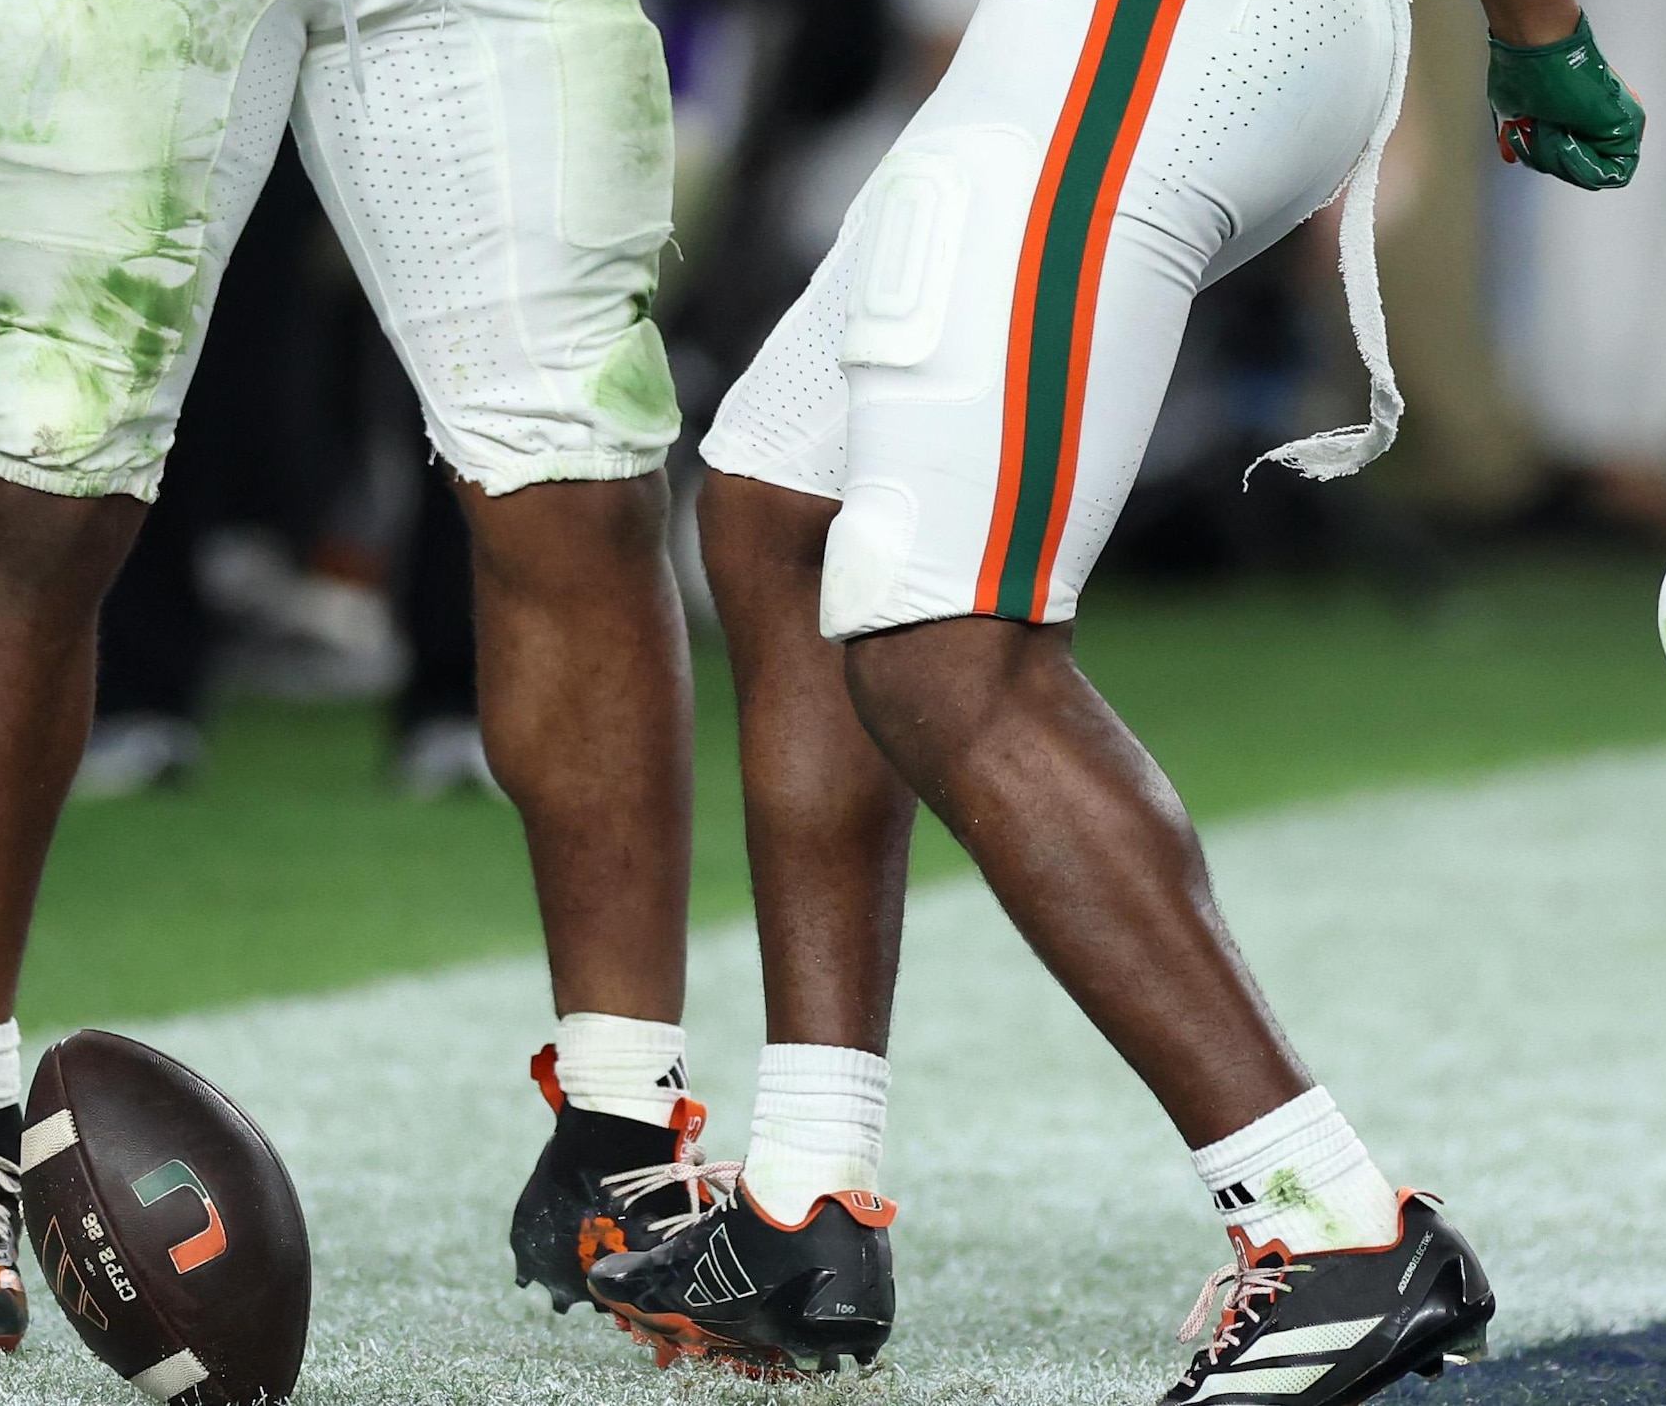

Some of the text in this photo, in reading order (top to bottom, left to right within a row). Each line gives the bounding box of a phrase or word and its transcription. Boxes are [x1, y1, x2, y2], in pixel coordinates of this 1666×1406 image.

[851, 1191, 883, 1212] U
[131, 1159, 227, 1275] U
[835, 1302, 857, 1314] 100
